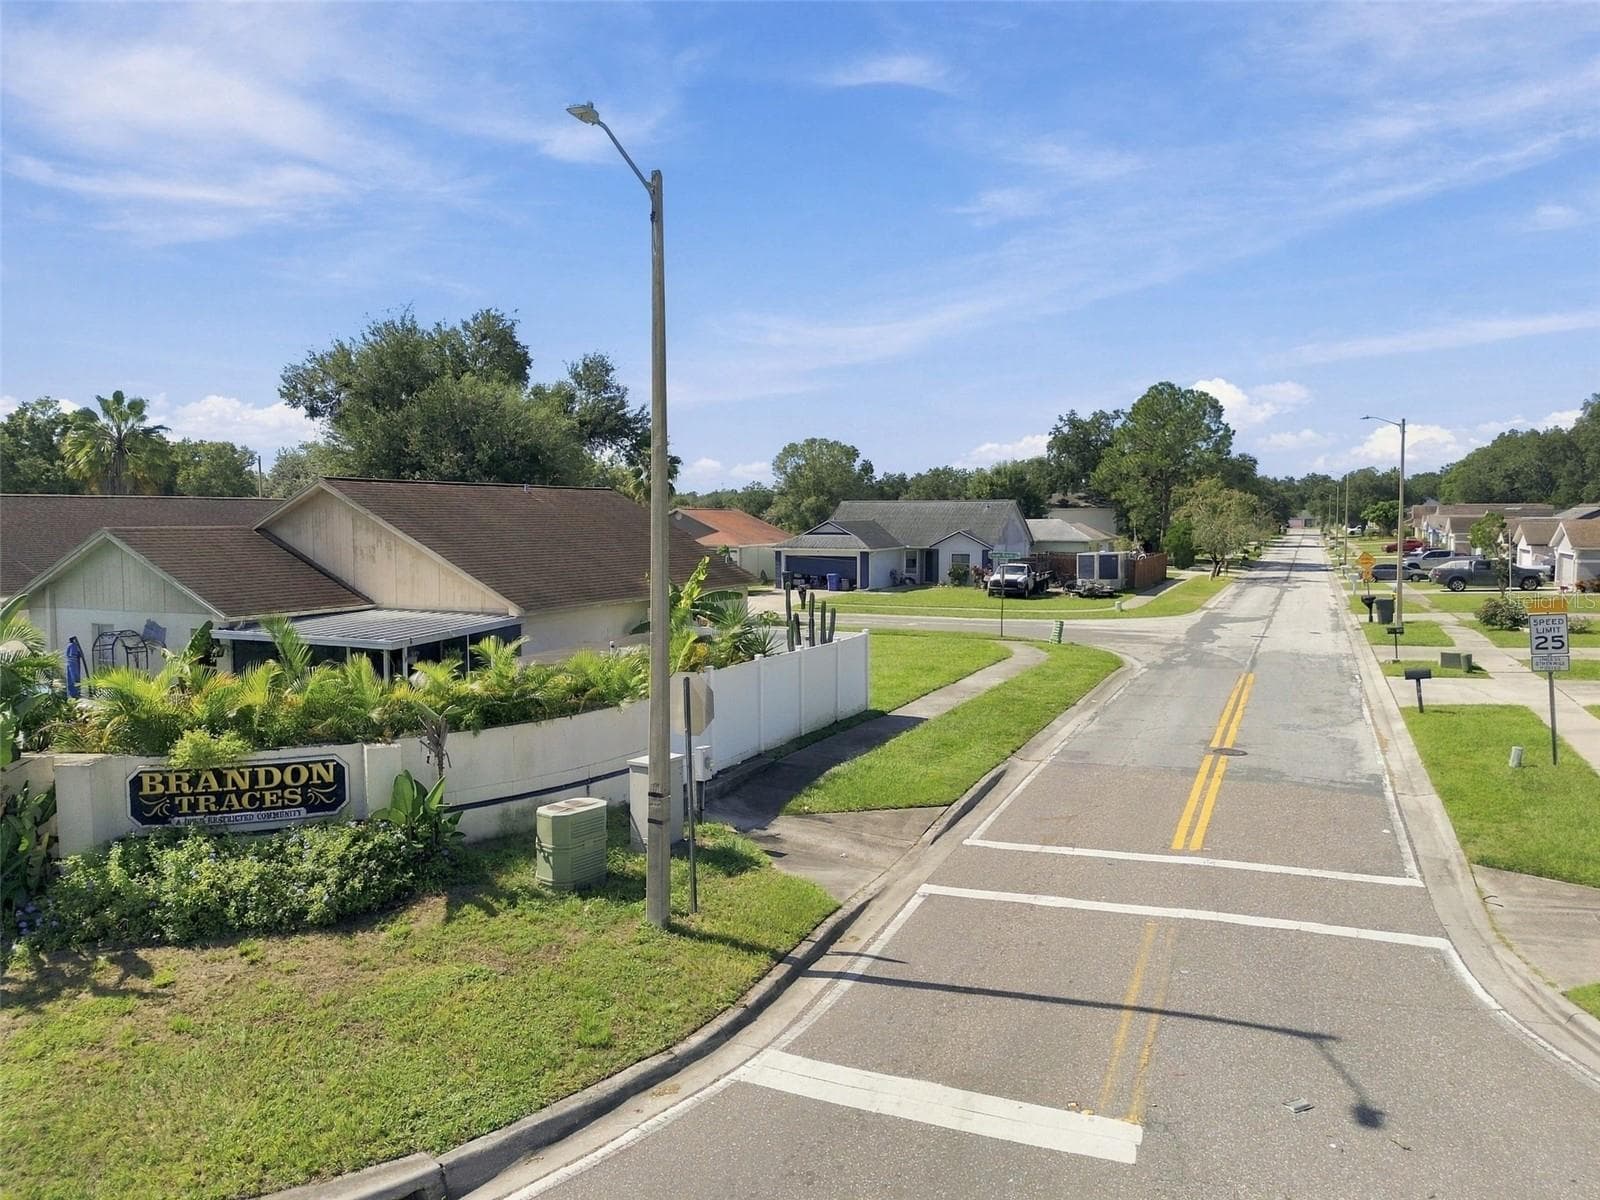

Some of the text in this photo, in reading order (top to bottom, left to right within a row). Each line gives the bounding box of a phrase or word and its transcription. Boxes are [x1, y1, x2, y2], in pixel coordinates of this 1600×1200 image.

[1533, 618, 1564, 626] SPEED
[1536, 626, 1560, 634] LIMIT
[1534, 635, 1565, 650] 25
[138, 762, 337, 795] BRANDON
[174, 787, 302, 814] TRACES
[257, 810, 303, 820] COMMUNITY
